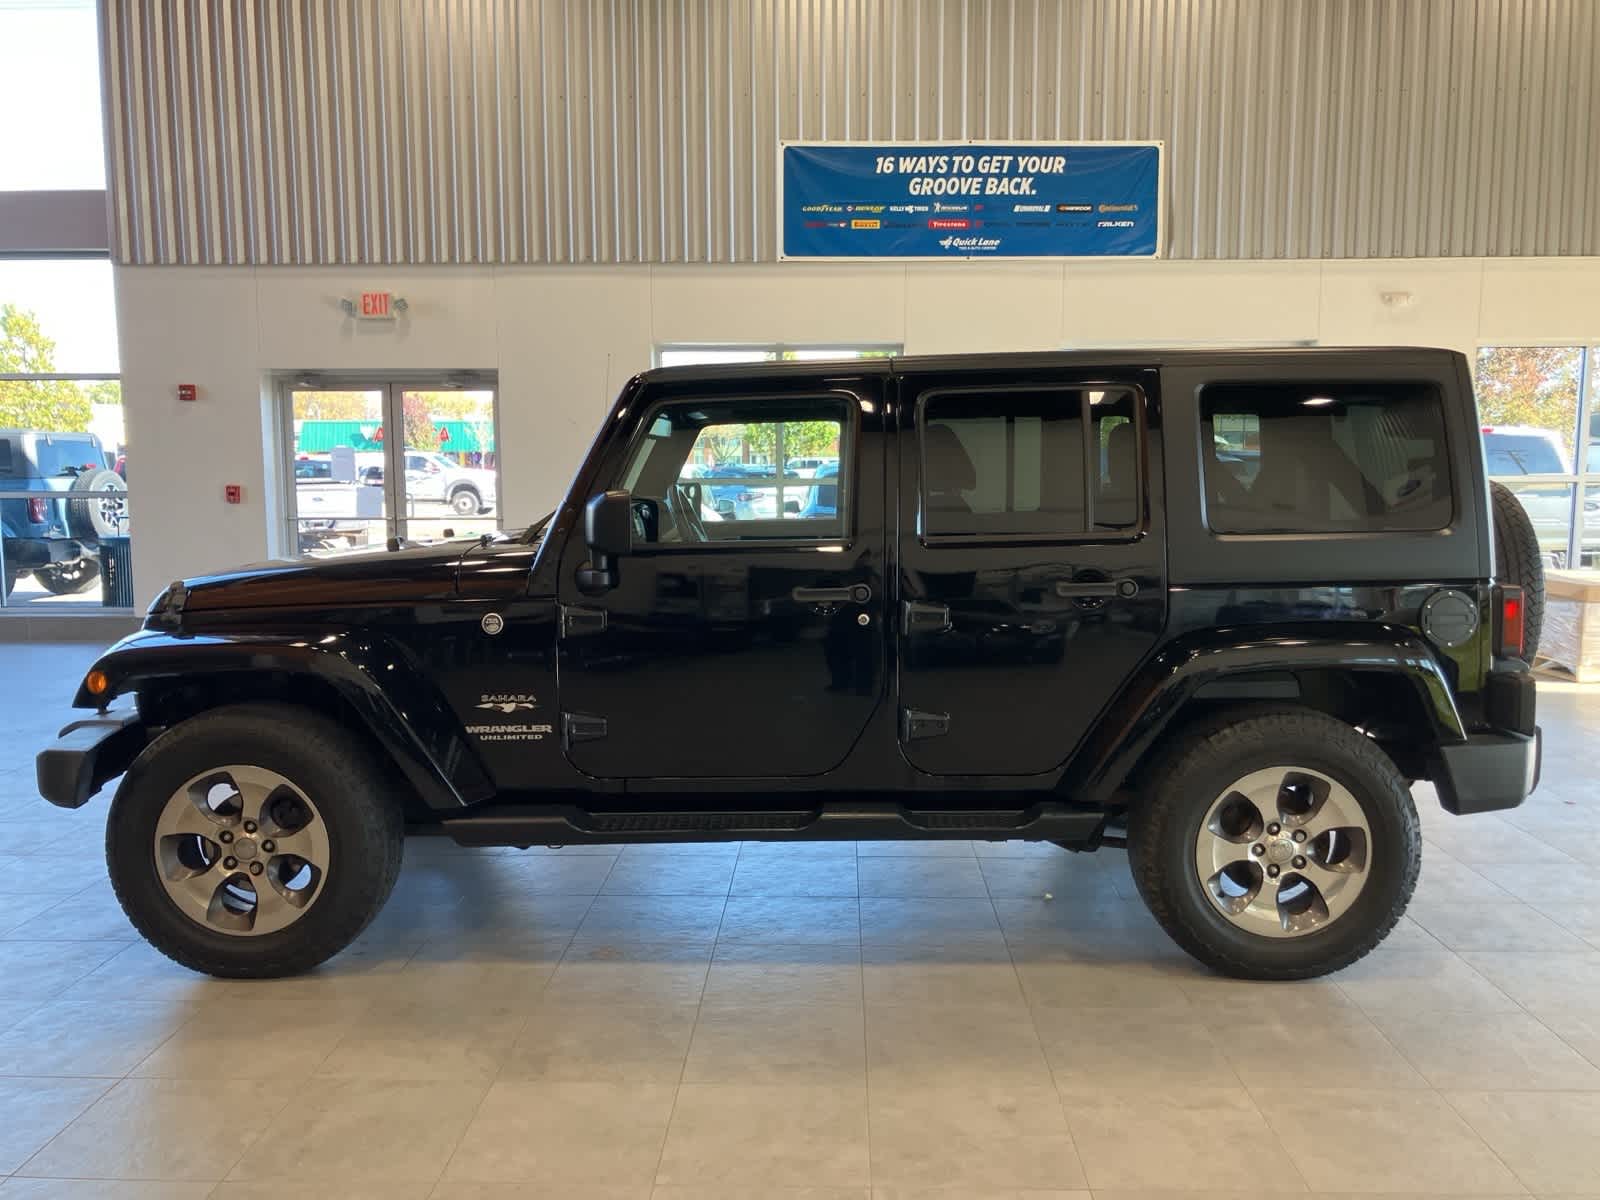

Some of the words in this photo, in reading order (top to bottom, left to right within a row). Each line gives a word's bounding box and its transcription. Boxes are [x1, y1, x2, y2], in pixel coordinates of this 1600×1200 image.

[875, 156, 895, 174] 16
[898, 155, 949, 174] WAYS
[952, 155, 975, 173] TO
[977, 155, 1012, 173] GET
[1017, 156, 1066, 174] YOUR
[908, 177, 983, 196] GROOVE
[984, 177, 1037, 195] BACK.
[952, 237, 977, 247] Quick
[978, 238, 1000, 246] Lane
[362, 293, 389, 316] EXIT
[481, 694, 537, 702] SAHARA
[464, 724, 553, 734] WRANGLER
